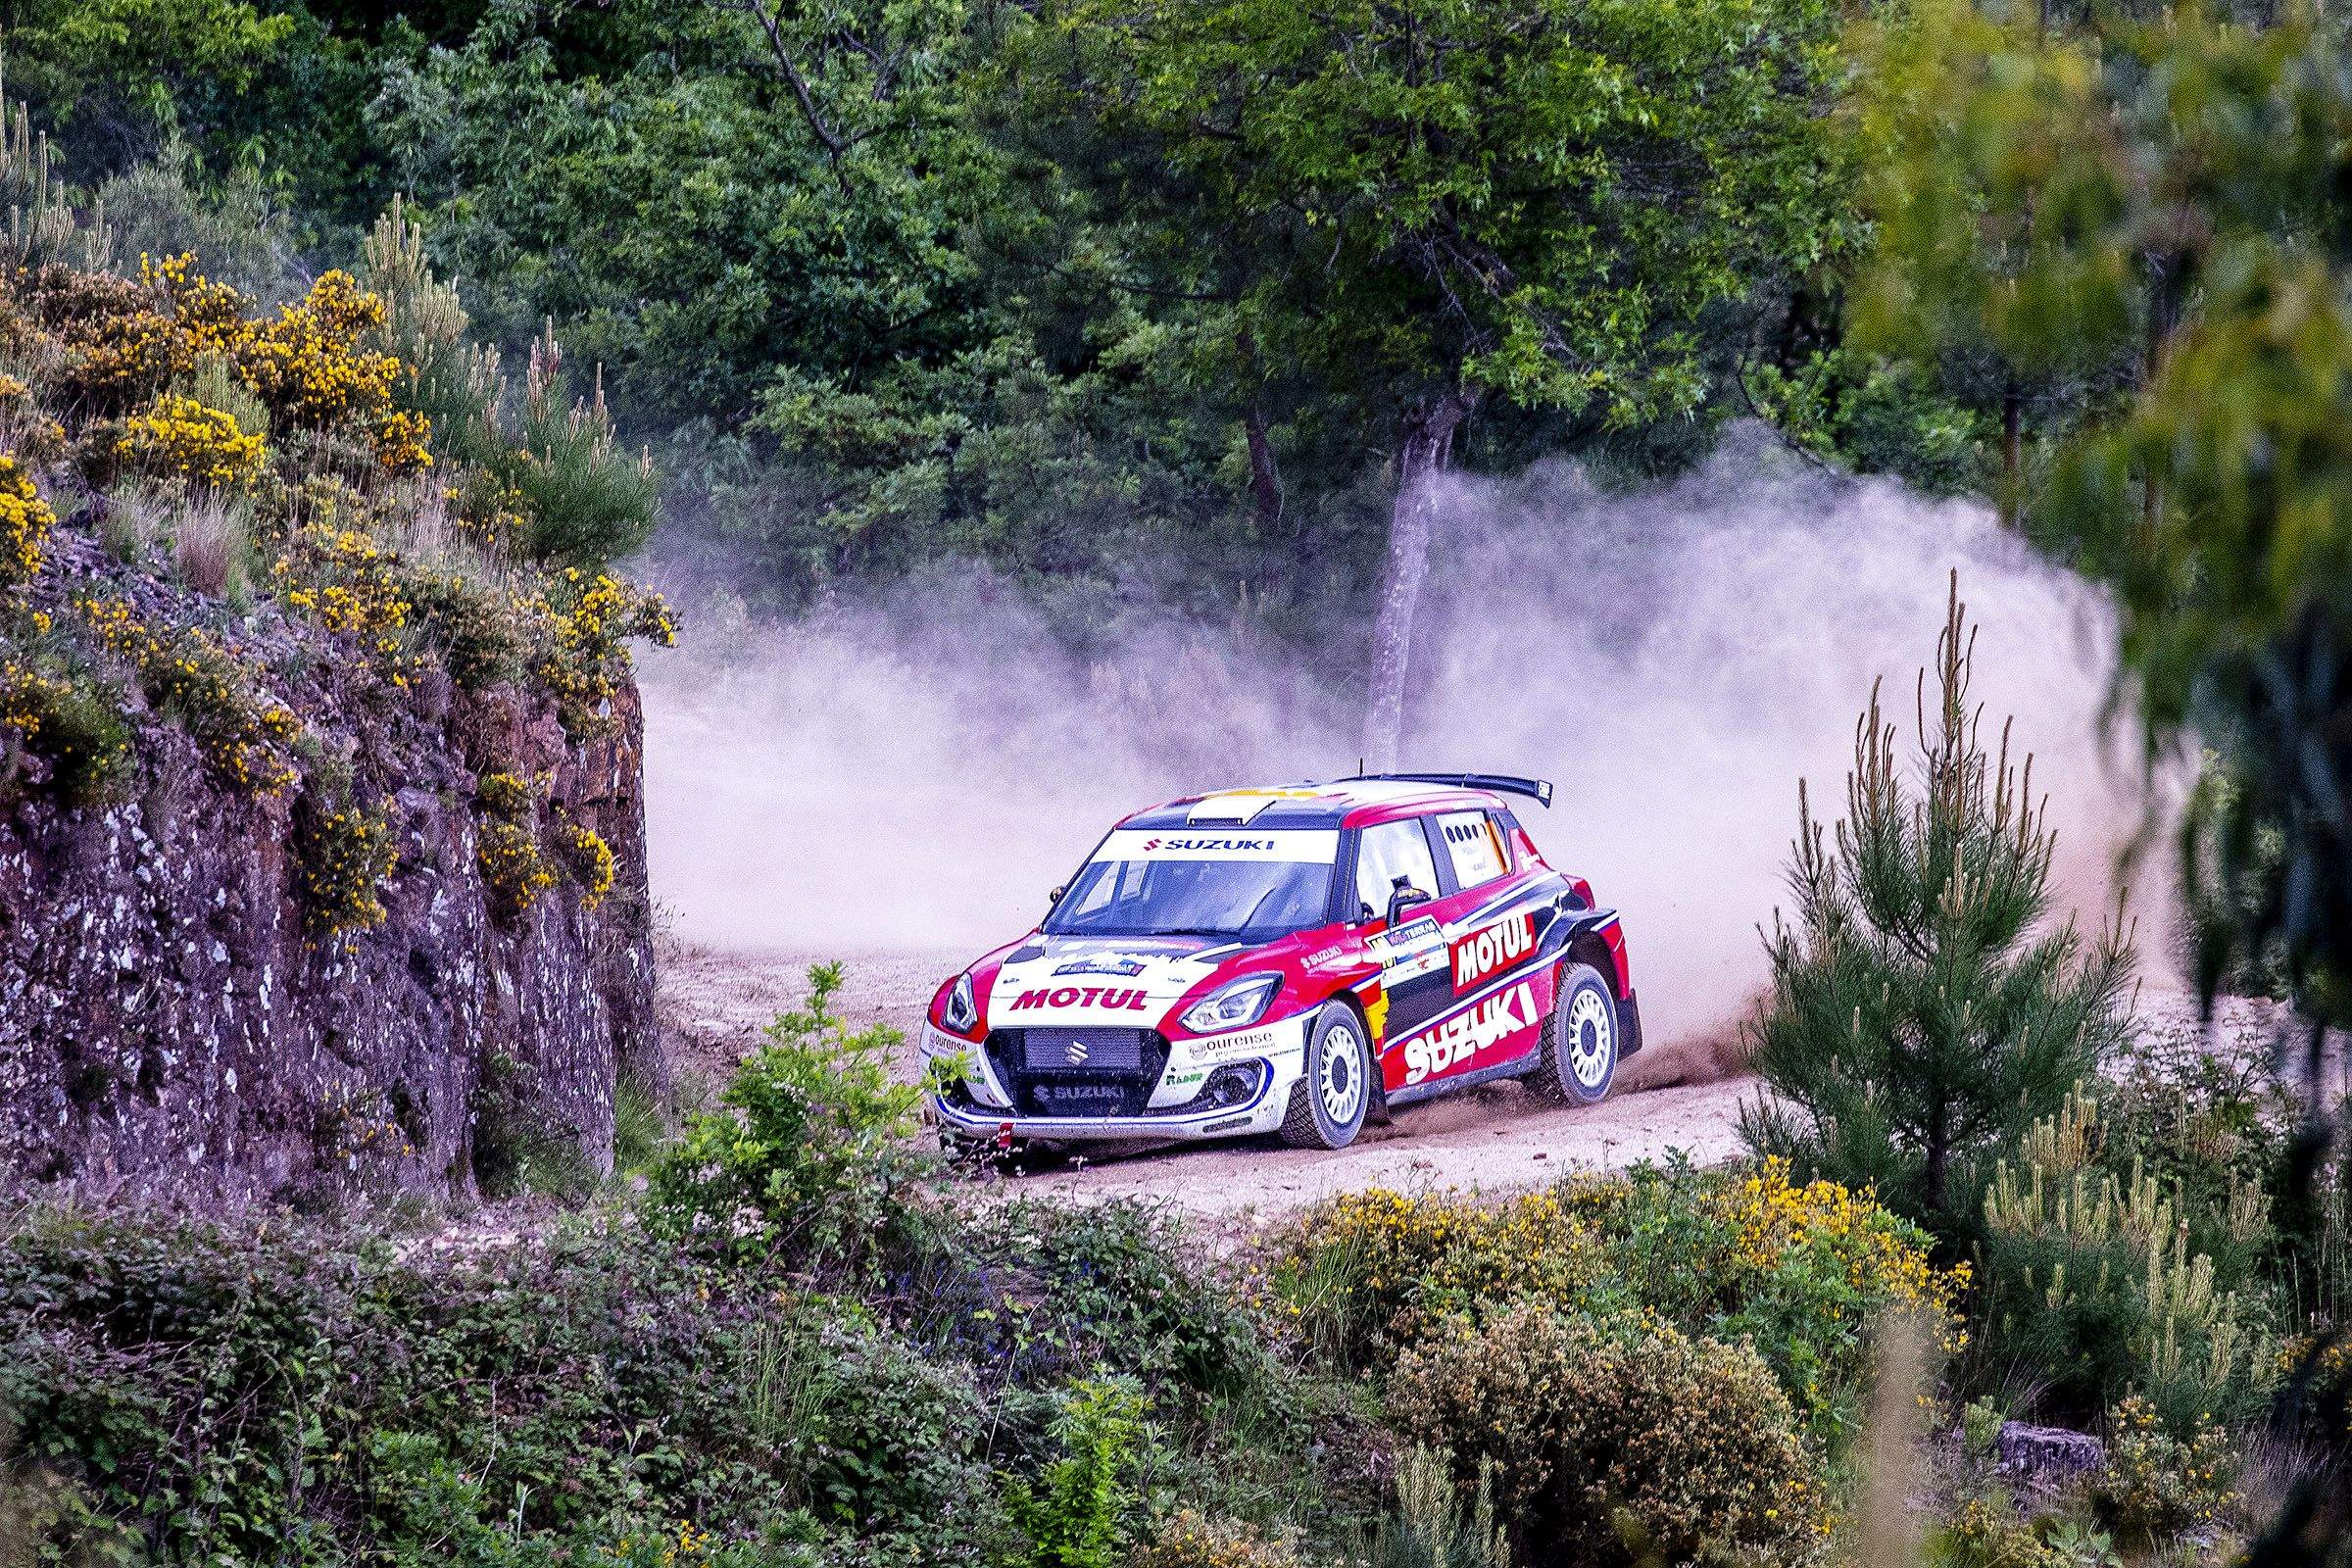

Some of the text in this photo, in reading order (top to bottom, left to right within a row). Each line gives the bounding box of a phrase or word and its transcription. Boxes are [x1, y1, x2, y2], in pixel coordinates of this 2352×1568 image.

[1164, 839, 1275, 851] SUZUKI
[1308, 945, 1343, 965] SUZUKI
[1457, 914, 1533, 988] MOTUL
[1008, 987, 1149, 1011] MOTUL
[1206, 1032, 1273, 1051] ourense
[1404, 981, 1539, 1086] SUZUKI
[1054, 1085, 1125, 1099] SUZUKI
